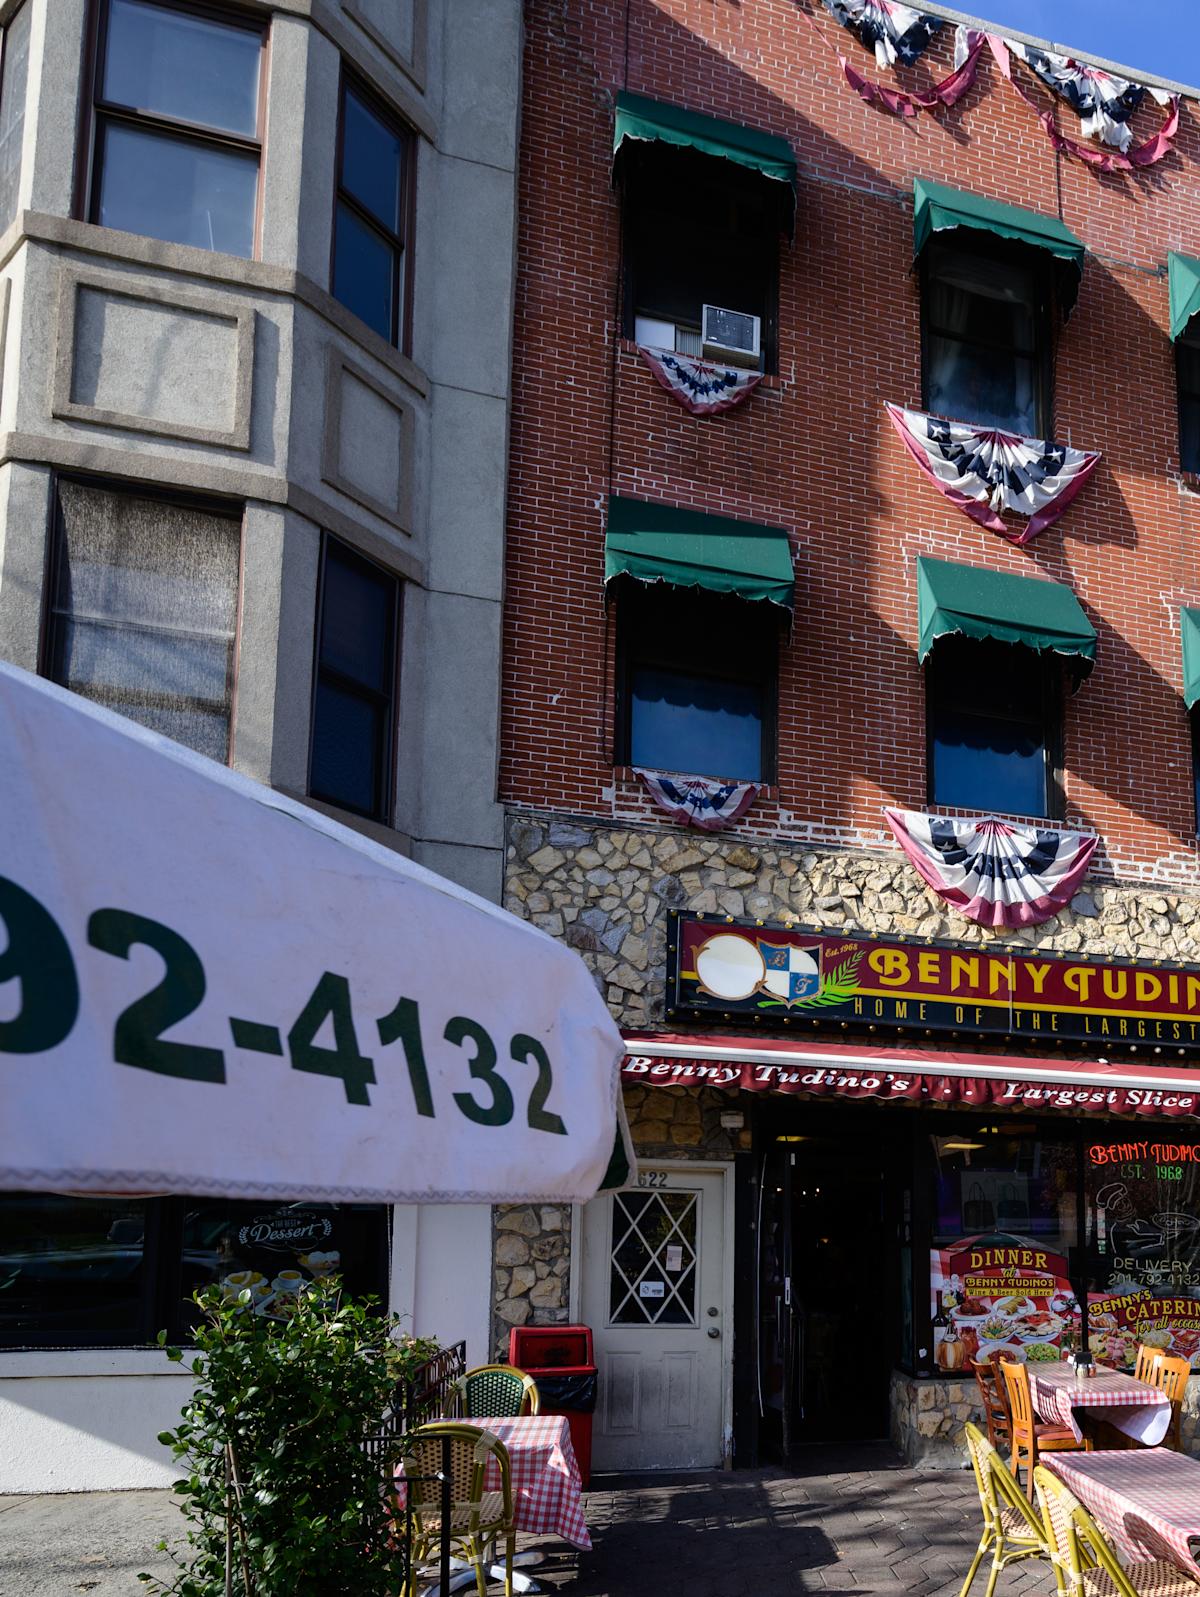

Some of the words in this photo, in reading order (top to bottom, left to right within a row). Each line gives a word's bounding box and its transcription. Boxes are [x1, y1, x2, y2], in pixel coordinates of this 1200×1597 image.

[840, 943, 858, 953] 1968
[868, 948, 1052, 995] BENNY
[854, 997, 927, 1020] HOME
[956, 1006, 983, 1024] OF
[1015, 1010, 1058, 1031] THE
[1085, 1016, 1196, 1041] LARGEST
[622, 1056, 742, 1084] Benny
[754, 1064, 910, 1091] Tudino's
[1003, 1082, 1118, 1106] Largest
[1125, 1089, 1193, 1109] Slice
[637, 1171, 668, 1187] 622
[1155, 1165, 1183, 1180] 1968
[250, 1223, 322, 1242] Dessert
[971, 1249, 1048, 1269] DINNER
[1113, 1257, 1192, 1273] DELIVERY
[1002, 1265, 1017, 1278] at
[1108, 1273, 1200, 1286] 201-792-4132
[965, 1278, 1006, 1287] BENNY
[1008, 1278, 1054, 1287] TUDINO'S
[1015, 1288, 1031, 1296] Sold
[1089, 1289, 1153, 1317] BENNY'S
[1134, 1318, 1152, 1338] for
[1154, 1315, 1169, 1330] all
